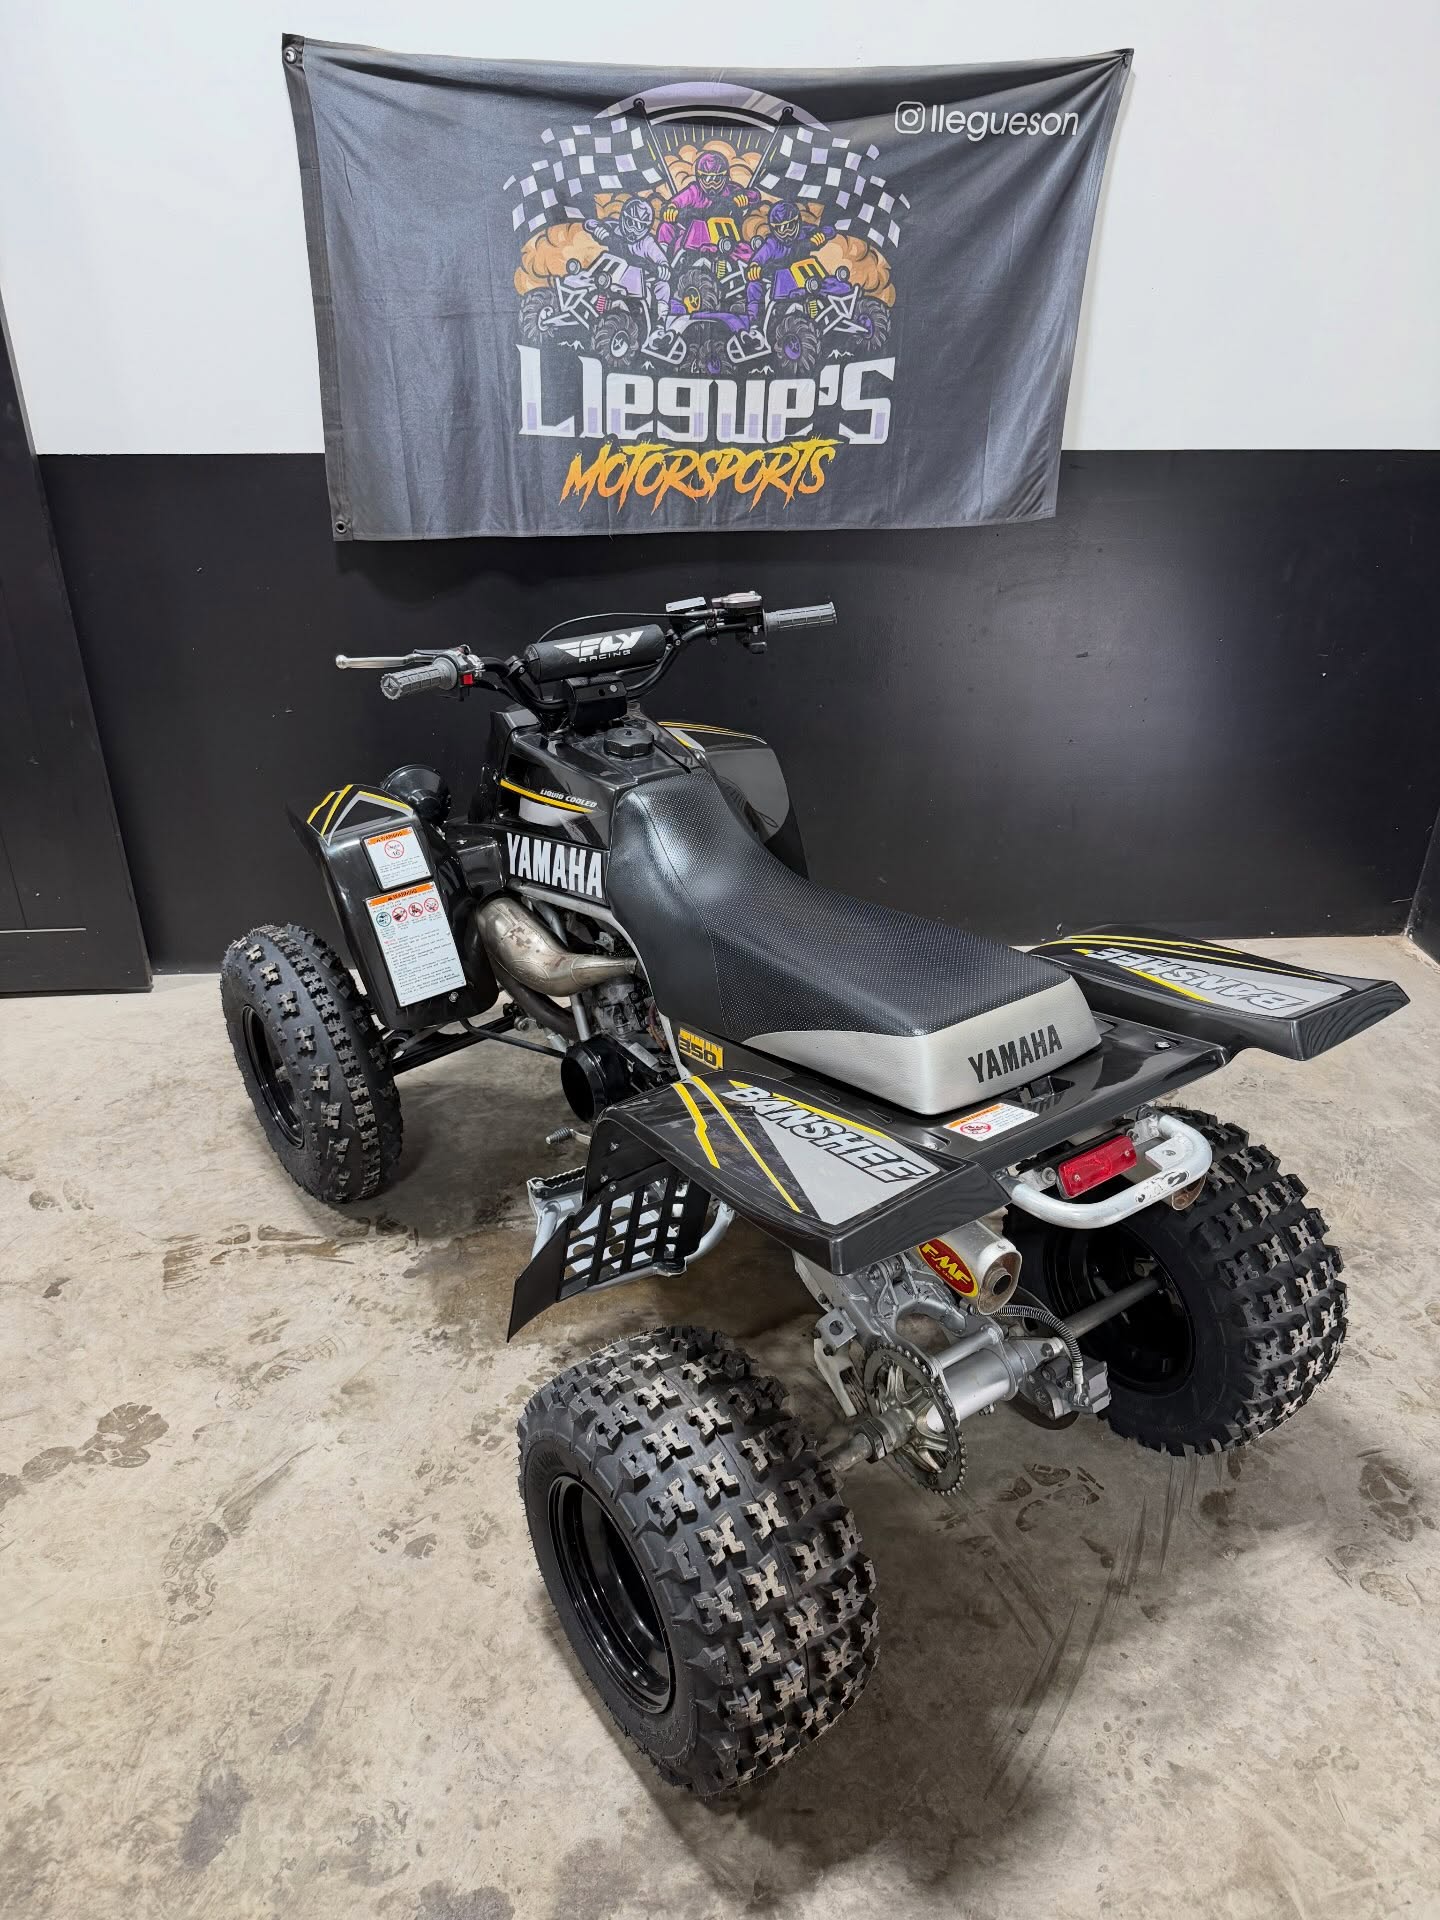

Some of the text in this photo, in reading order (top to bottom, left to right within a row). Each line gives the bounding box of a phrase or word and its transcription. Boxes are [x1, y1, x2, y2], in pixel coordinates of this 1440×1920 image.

[931, 104, 1079, 142] llegueson
[559, 433, 844, 515] MOTORSPORTS
[554, 630, 644, 658] FLY
[578, 649, 631, 663] RACING
[540, 789, 598, 808] LIQUID COOLED
[506, 832, 603, 899] YAMAHA
[1086, 947, 1311, 1011] BANSHEE
[679, 1036, 718, 1068] 350
[967, 1024, 1063, 1084] YAMAHA
[720, 1086, 932, 1184] BANSHEE
[921, 1242, 972, 1285] FMF
